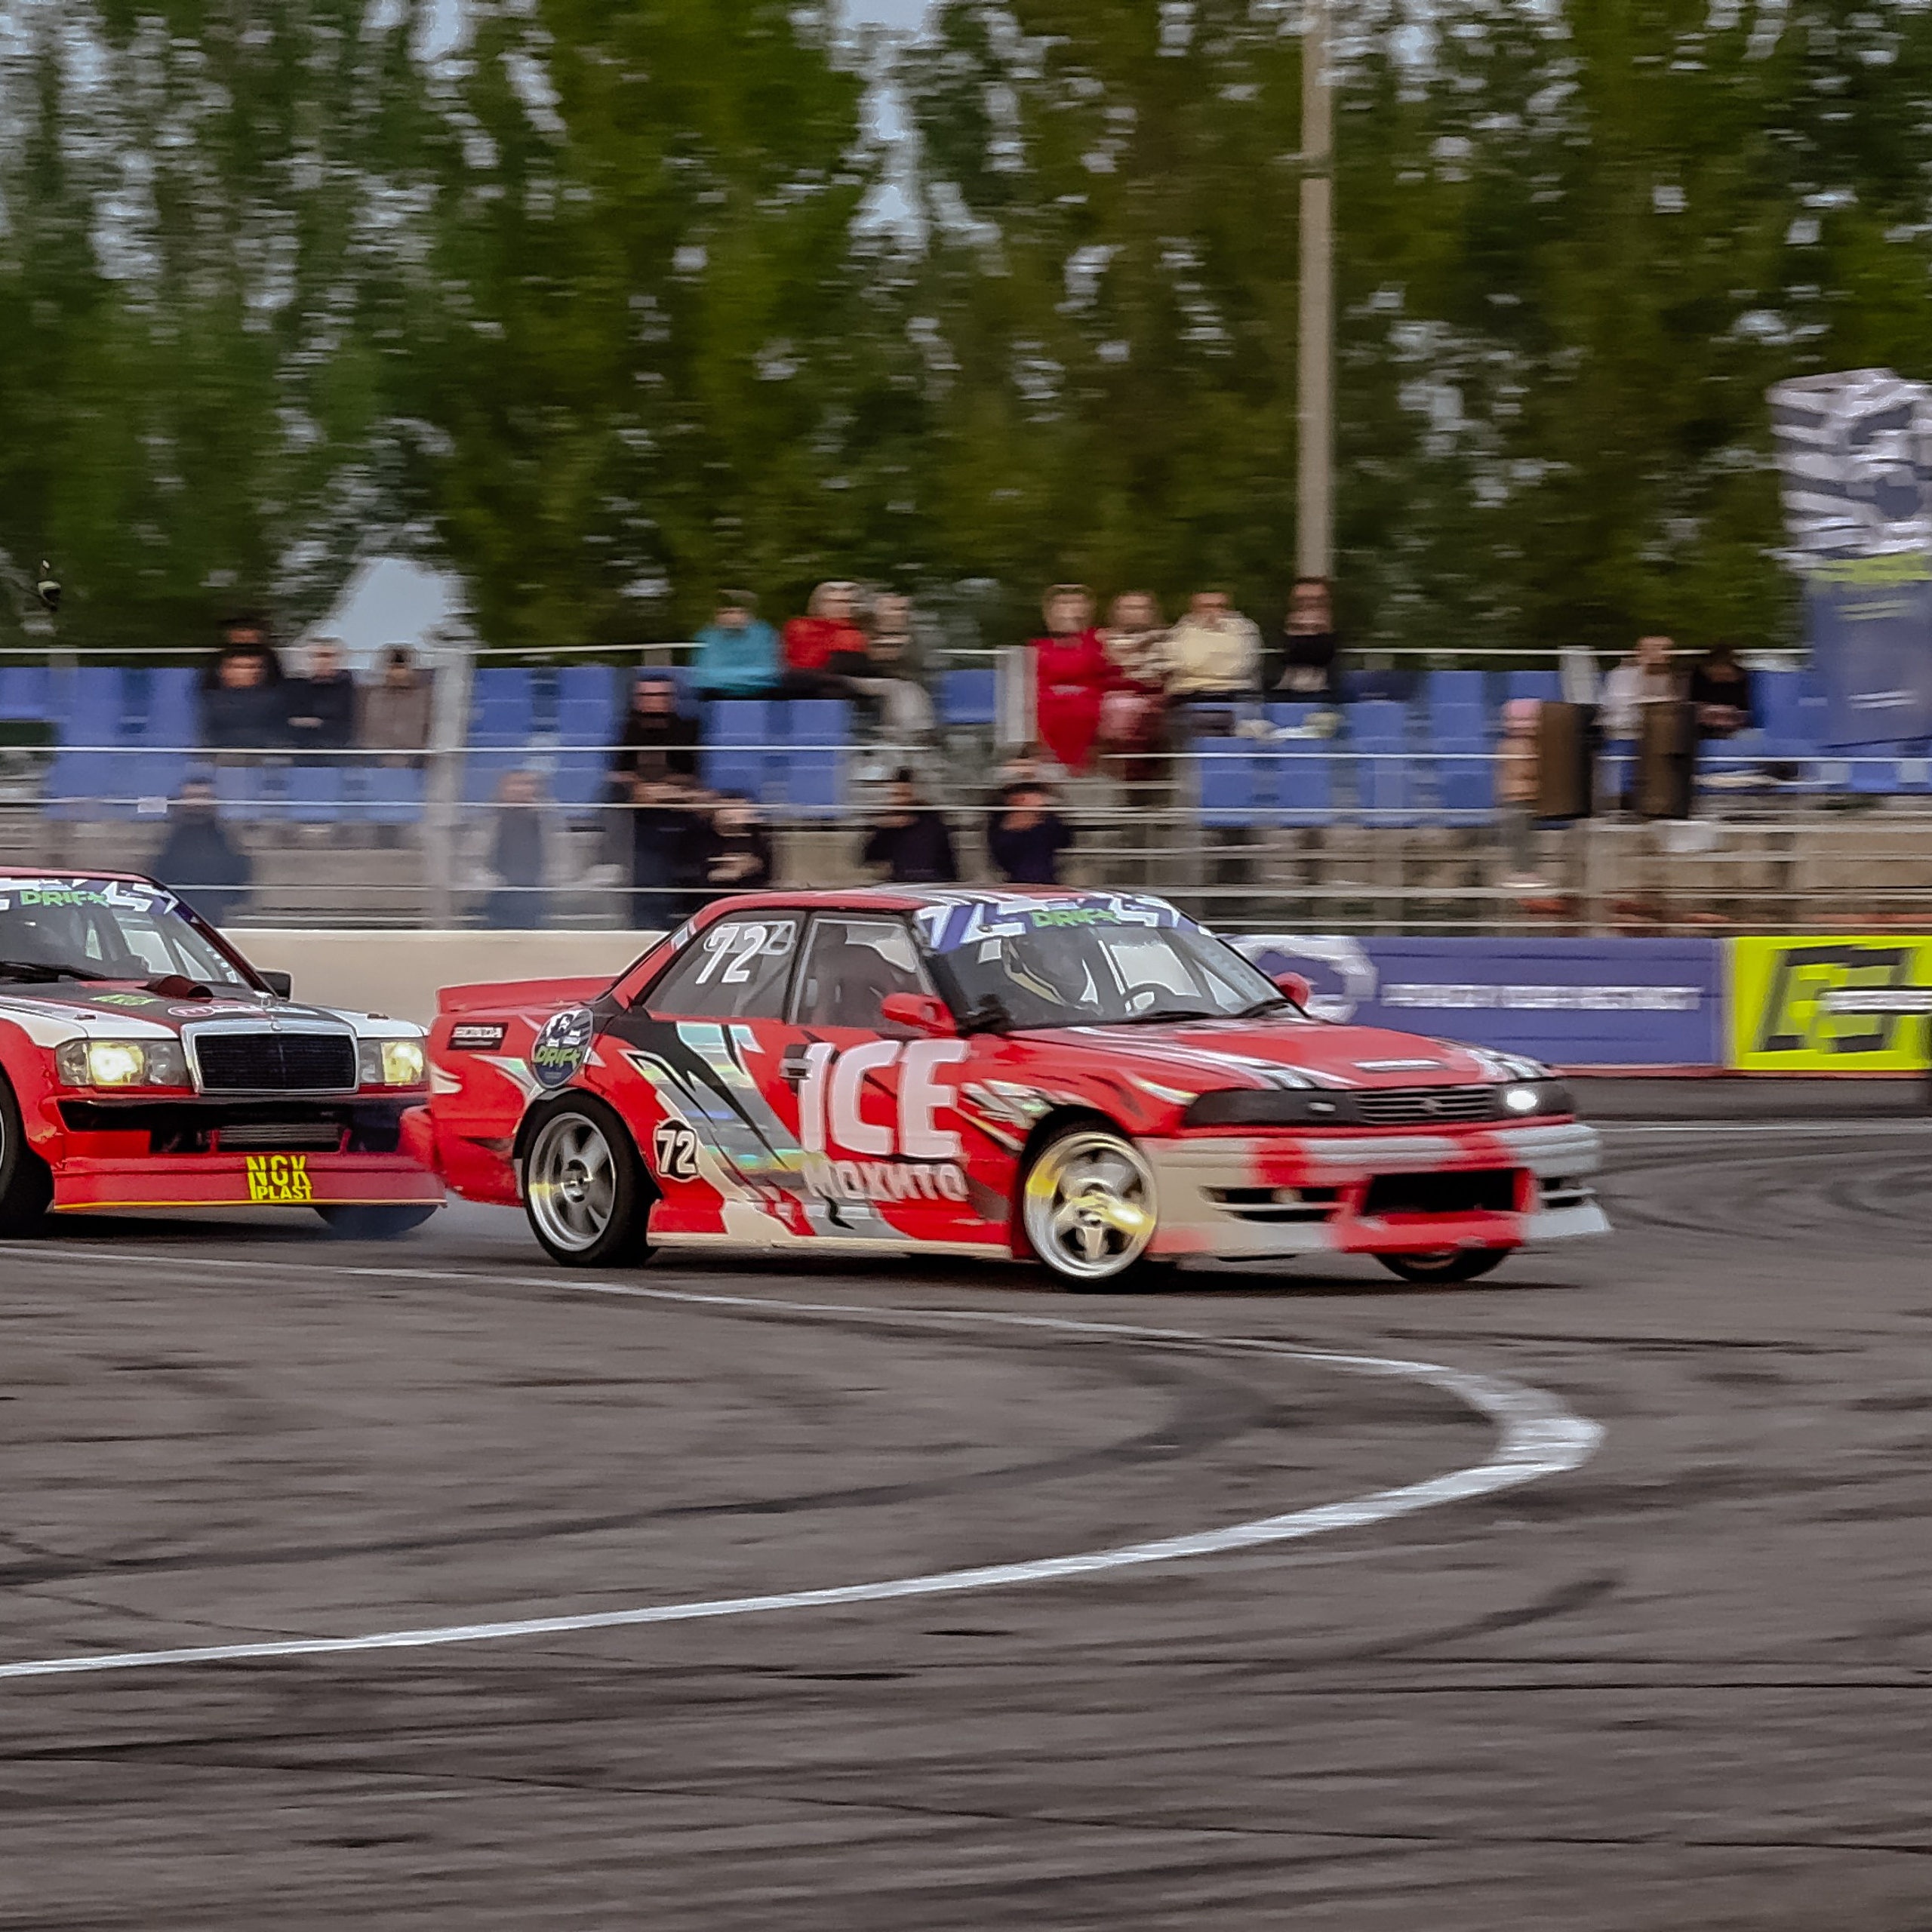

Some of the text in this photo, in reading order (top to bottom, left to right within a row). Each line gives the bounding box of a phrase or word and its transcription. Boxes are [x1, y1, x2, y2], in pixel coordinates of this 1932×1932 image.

[696, 925, 768, 984] 72
[799, 1039, 970, 1158] ICE
[657, 1129, 696, 1174] 72
[246, 1155, 312, 1200] NGK
[257, 1185, 312, 1200] PLAST
